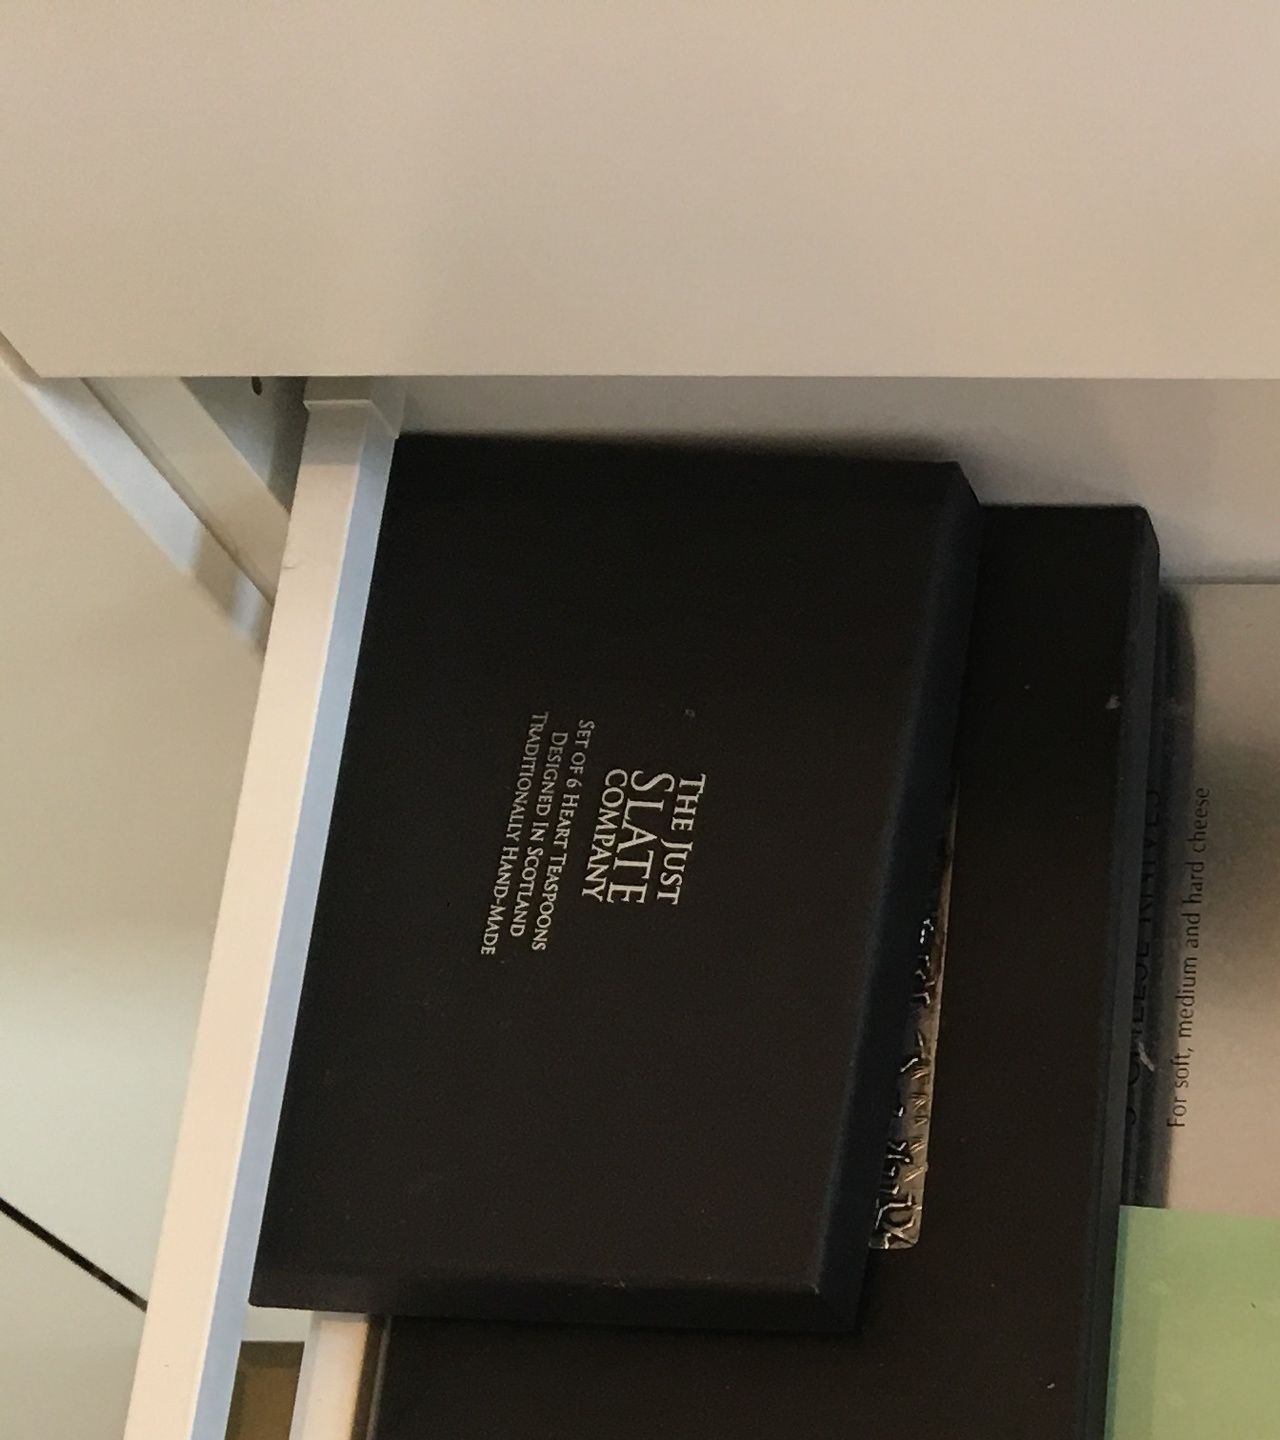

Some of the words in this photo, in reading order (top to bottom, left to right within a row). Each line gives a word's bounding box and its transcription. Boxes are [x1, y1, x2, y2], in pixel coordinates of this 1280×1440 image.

[574, 719, 594, 749] SET
[506, 712, 548, 841] TRADITIONALLY
[536, 732, 568, 816] DESIGNED
[566, 778, 582, 788] 6
[670, 773, 706, 831] THE
[552, 793, 579, 849] HEART
[582, 768, 628, 902] COMPANY
[606, 770, 674, 904] SLATE
[1187, 787, 1210, 853] cheese
[480, 846, 518, 955] HAND-MADE
[509, 847, 543, 937] SCOTLAND
[532, 853, 566, 951] TEASPOONS
[656, 838, 693, 905] JUST
[1181, 862, 1205, 904] hard
[1181, 912, 1201, 949] and
[1176, 957, 1198, 1038] medium
[1169, 1047, 1194, 1089] soft,
[1167, 1096, 1187, 1127] For
